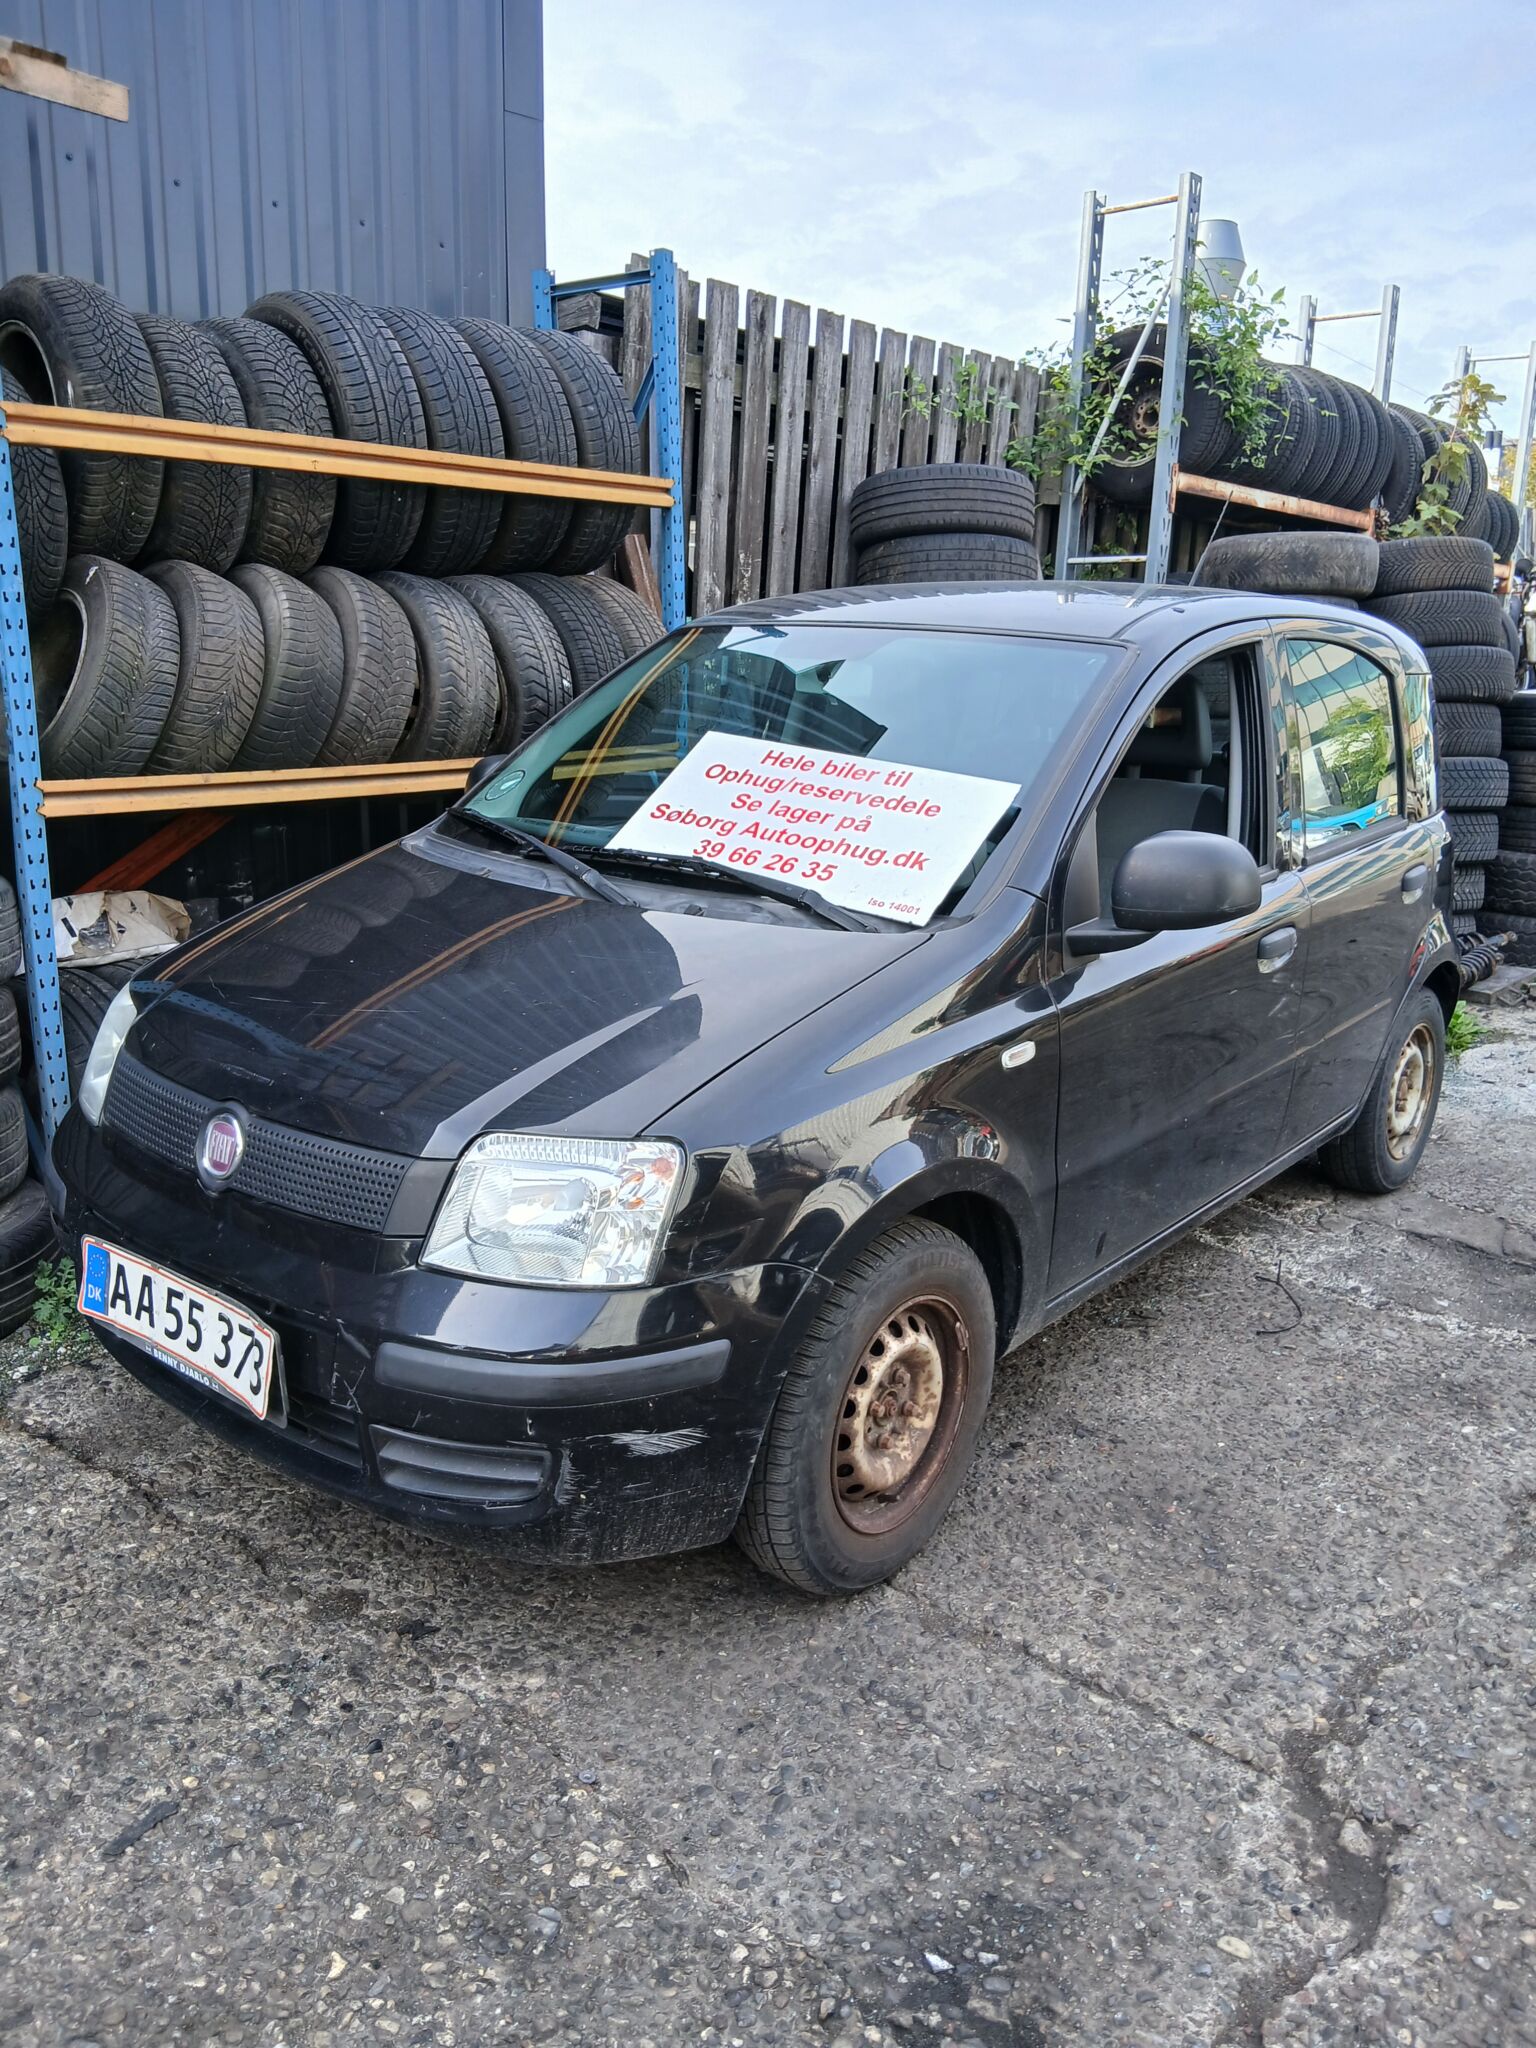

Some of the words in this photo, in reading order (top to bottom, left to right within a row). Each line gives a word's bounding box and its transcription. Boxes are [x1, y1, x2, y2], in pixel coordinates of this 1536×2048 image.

[760, 750, 815, 772] Hele
[820, 760, 880, 782] biler
[884, 770, 913, 788] til
[704, 764, 942, 817] Ophug/reservedele
[731, 793, 763, 812] Se
[768, 800, 834, 825] lager
[834, 815, 872, 832] på
[650, 803, 738, 837] Søborg
[739, 821, 930, 871] Autoophug.dk
[693, 839, 726, 858] 39
[728, 847, 762, 866] 66
[763, 854, 799, 874] 26
[801, 861, 838, 881] 35
[889, 901, 920, 915] 14001
[209, 1129, 235, 1165] FIAT
[87, 1284, 102, 1302] DK
[110, 1263, 155, 1329] AA
[164, 1286, 204, 1352] 55
[213, 1312, 264, 1396] 373
[153, 1349, 178, 1369] BENNY
